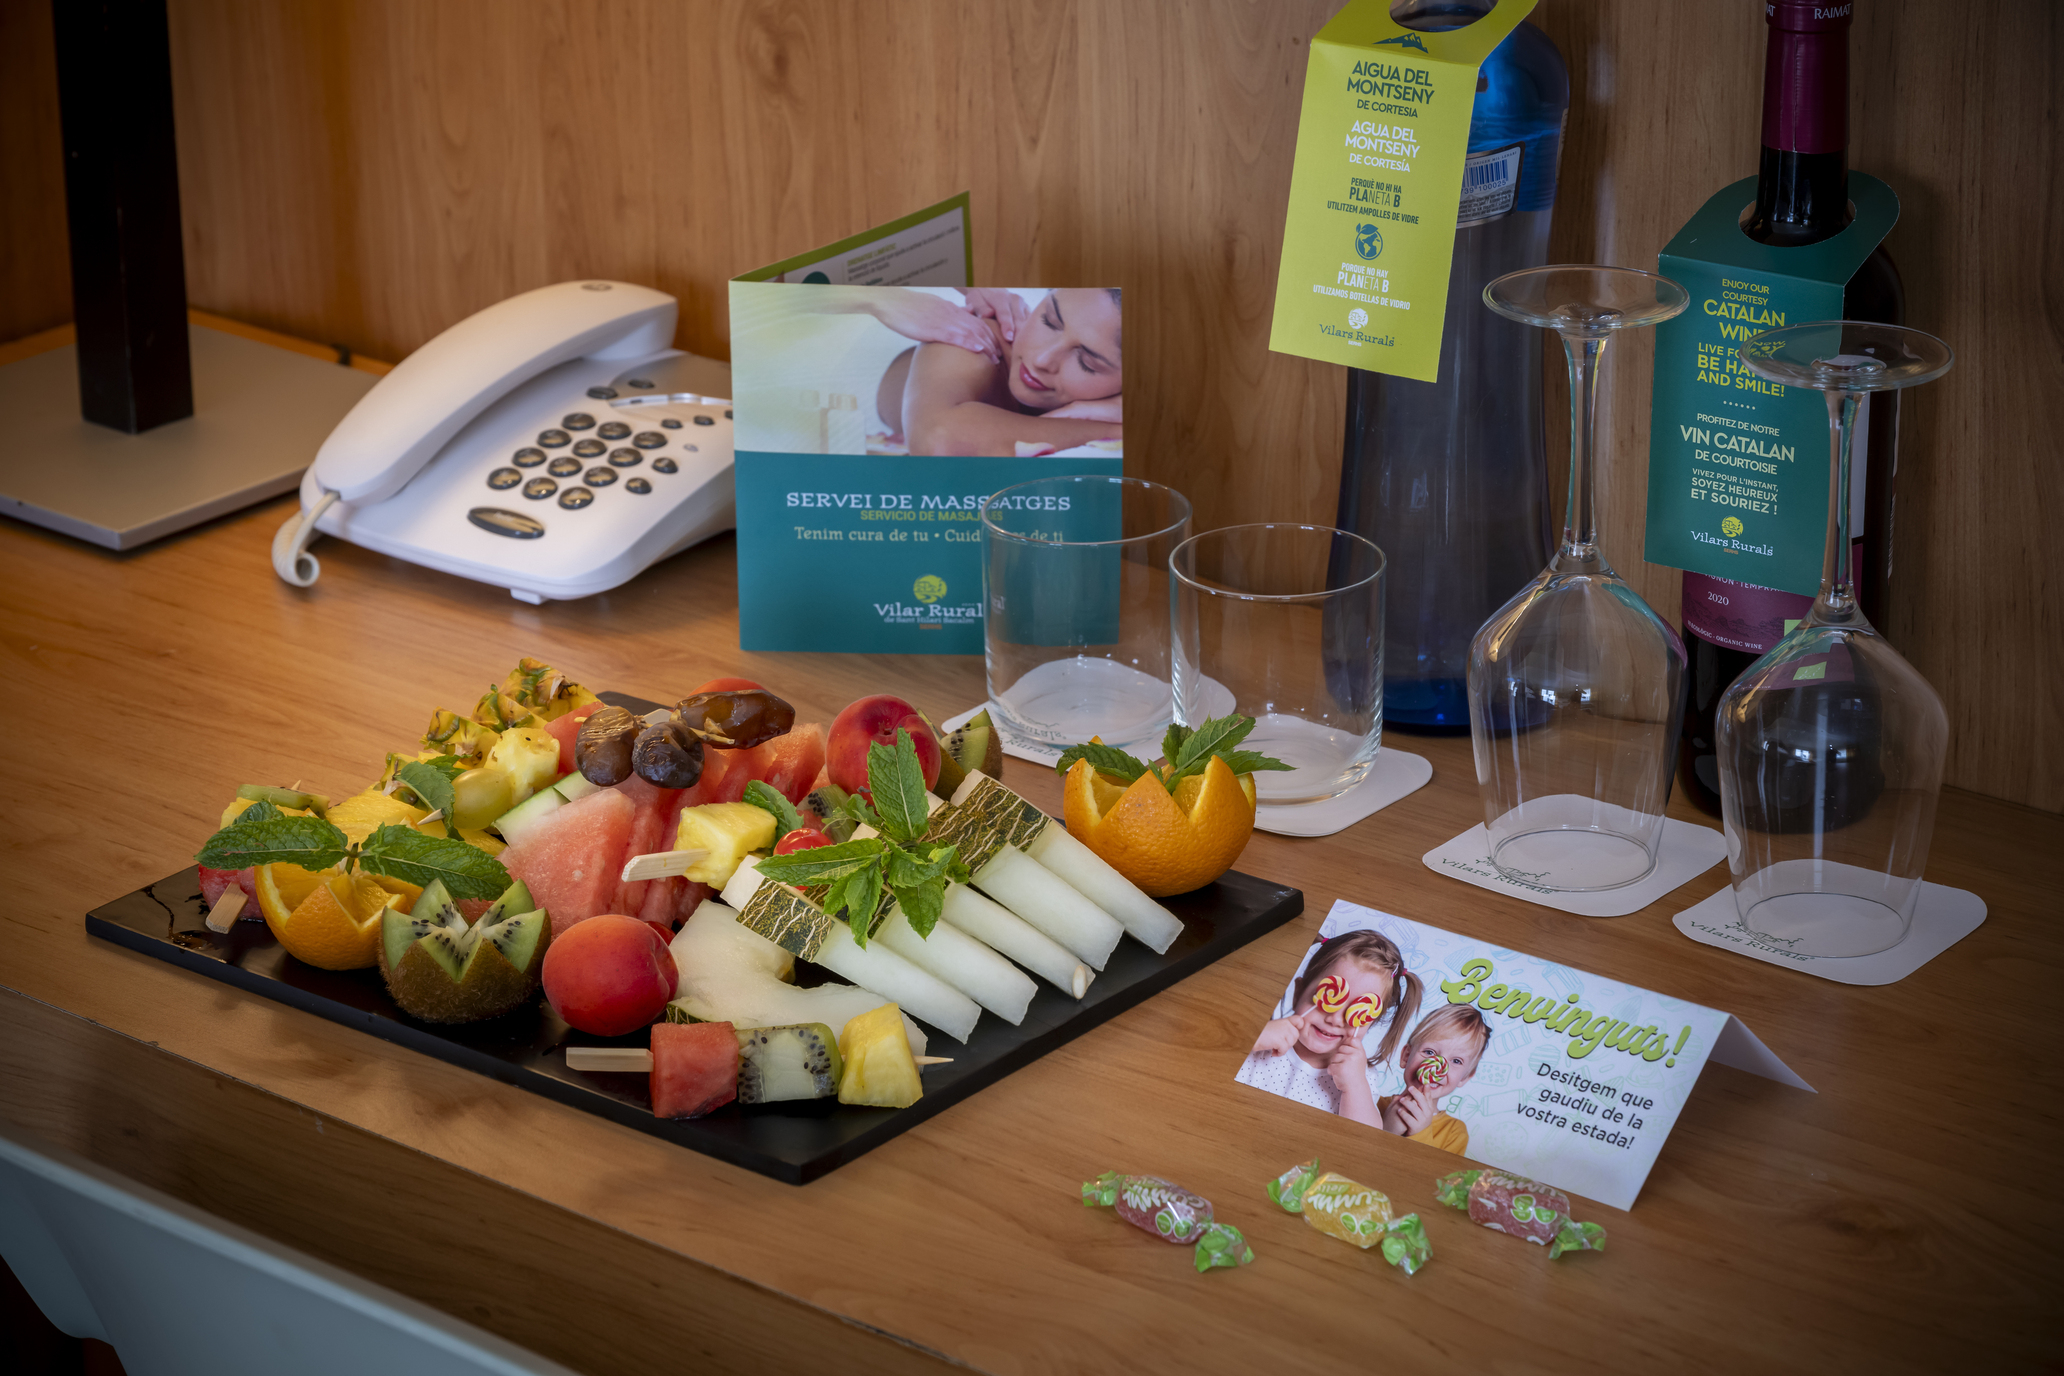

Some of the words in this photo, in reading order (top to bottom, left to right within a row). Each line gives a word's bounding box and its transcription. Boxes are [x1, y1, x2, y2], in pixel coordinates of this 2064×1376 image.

[1814, 3, 1851, 20] RAIMAT
[1352, 60, 1401, 82] AIGUA
[1404, 68, 1433, 87] DEL
[1347, 77, 1435, 105] MONTSENY
[1357, 99, 1370, 110] DE
[1371, 102, 1418, 118] CORTESIA
[1351, 120, 1390, 139] AGUA
[1392, 126, 1417, 143] DEL
[1345, 133, 1420, 158] MONTSENY
[1349, 153, 1362, 164] DE
[1364, 156, 1411, 172] CORTESÍA
[1351, 177, 1375, 189] PERQUÈ
[1376, 181, 1385, 191] NO
[1386, 183, 1392, 192] HI
[1393, 185, 1402, 194] HA
[1479, 180, 1507, 192] 100025
[1349, 186, 1391, 206] PLANETA
[1393, 194, 1401, 208] B
[1327, 200, 1358, 213] UTILITZEM
[1359, 206, 1391, 220] AMPOLLES
[1392, 212, 1400, 222] DE
[1401, 213, 1419, 225] VIDRE
[1341, 262, 1365, 275] PORQUE
[1366, 266, 1375, 276] NO
[1376, 268, 1389, 279] HAY
[1337, 271, 1379, 292] PLANETA
[1382, 279, 1390, 293] B
[1722, 278, 1749, 291] ENJOY
[1750, 283, 1770, 294] OUR
[1313, 284, 1348, 299] UTILIZAMOS
[1349, 291, 1379, 305] BOTELLAS
[1380, 297, 1388, 306] DE
[1390, 298, 1411, 311] VIDRIO
[1722, 291, 1768, 306] COURTESY
[1703, 299, 1785, 327] CATALAN
[1319, 324, 1353, 339] Vilars
[1356, 331, 1395, 347] Rurals
[1698, 342, 1724, 356] LIVE
[1697, 354, 1720, 371] BE
[1697, 370, 1731, 386] AND
[1735, 377, 1785, 397] SMILE!
[1697, 413, 1736, 428] PROFITEZ
[1737, 421, 1749, 431] DE
[1750, 424, 1780, 436] NOTRE
[1680, 425, 1710, 446] VIN
[1714, 432, 1795, 463] CATALAN
[1695, 449, 1710, 461] DE
[1711, 453, 1777, 475] COURTOISIE
[1692, 468, 1715, 479] VIVEZ
[1716, 473, 1737, 484] POUR
[786, 492, 872, 508] SERVEI
[879, 494, 913, 509] DE
[1691, 477, 1726, 492] SOYEZ
[1728, 484, 1778, 502] HEUREUX
[1691, 488, 1707, 500] ET
[1711, 493, 1770, 514] SOURIEZ
[860, 510, 916, 521] SERVICIO
[919, 510, 935, 521] DE
[794, 526, 844, 540] Tenim
[848, 530, 884, 541] cura
[889, 529, 908, 541] de
[913, 530, 929, 542] tu
[1031, 529, 1048, 541] de
[1053, 531, 1064, 542] ti
[1690, 530, 1729, 547] Vilars
[1731, 539, 1774, 557] Rurals
[1707, 591, 1729, 606] 2020
[873, 602, 925, 617] Vilar
[928, 602, 984, 618] Rural
[1716, 635, 1743, 647] ORGANIC
[1744, 641, 1763, 650] WINE
[1442, 858, 1491, 877] Vilars
[1691, 921, 1742, 943] Vilars
[1745, 940, 1809, 961] Rurals
[1440, 958, 1692, 1068] Benvinguts!
[1537, 1062, 1617, 1099] Desitgem
[1621, 1092, 1654, 1111] que
[1538, 1088, 1598, 1116] gaudiu
[1602, 1107, 1624, 1123] de
[1628, 1113, 1643, 1130] la
[1517, 1103, 1567, 1129] vostra
[1571, 1121, 1635, 1150] estada!
